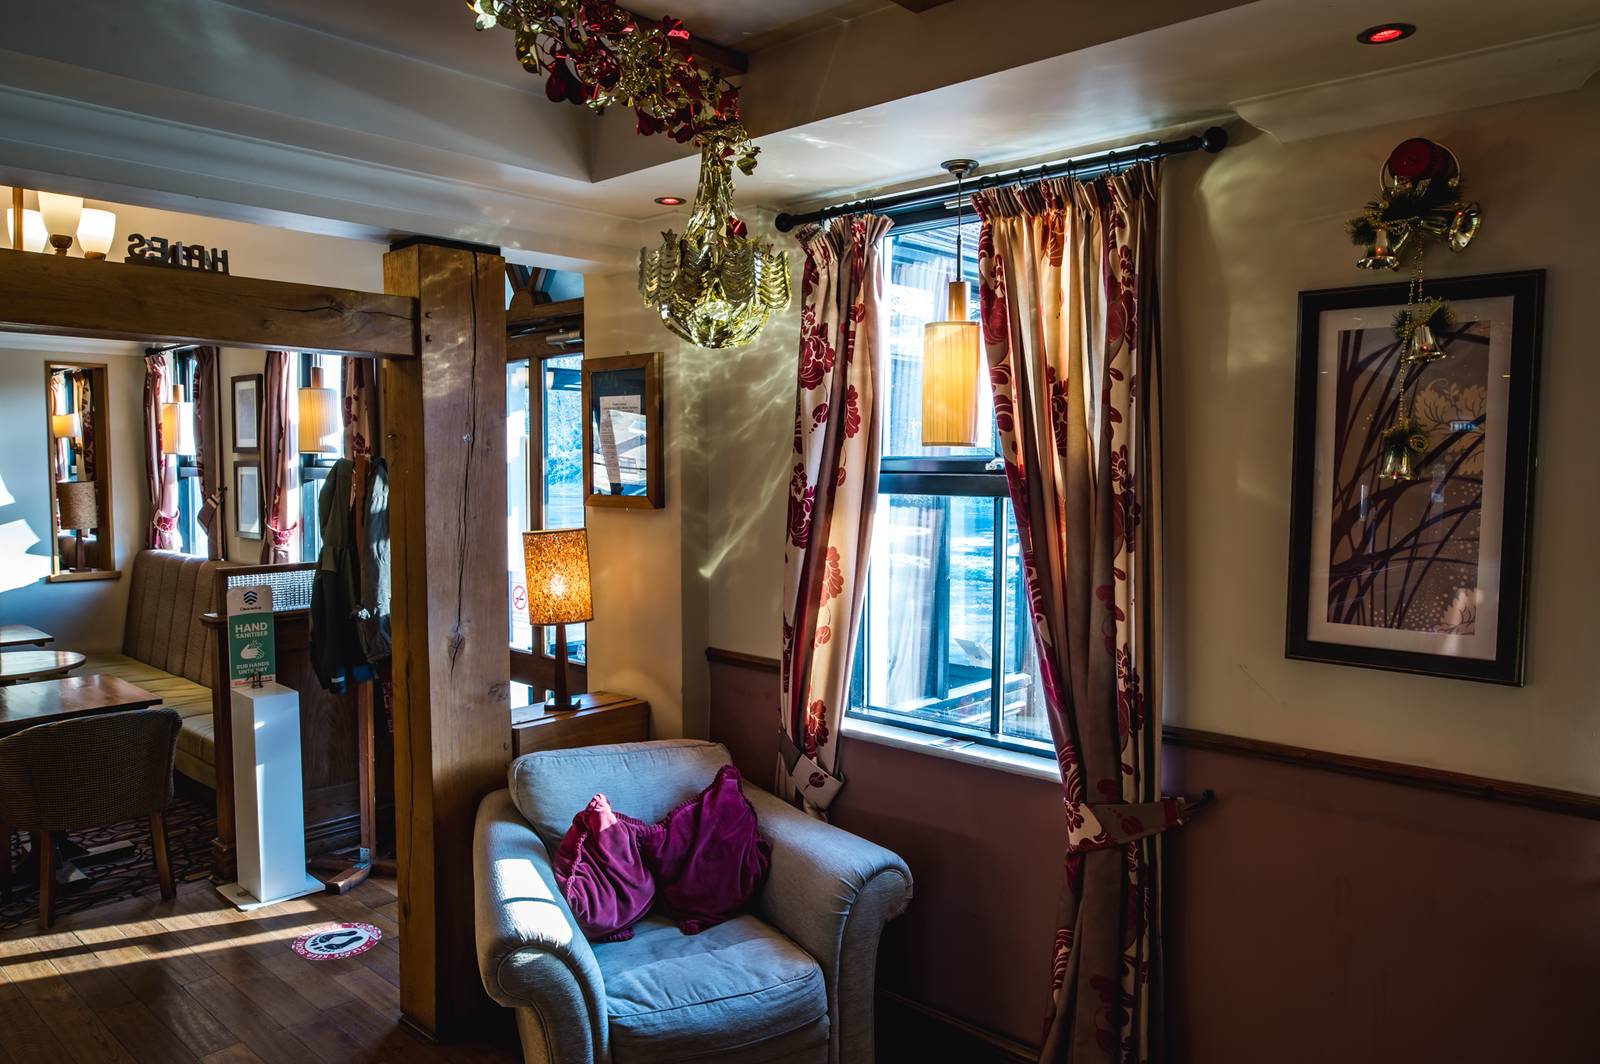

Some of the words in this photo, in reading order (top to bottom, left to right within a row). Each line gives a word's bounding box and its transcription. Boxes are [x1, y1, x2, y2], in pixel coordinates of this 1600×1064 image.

[235, 622, 268, 633] HAND
[235, 631, 268, 640] SANITISER
[248, 661, 270, 669] HANDS
